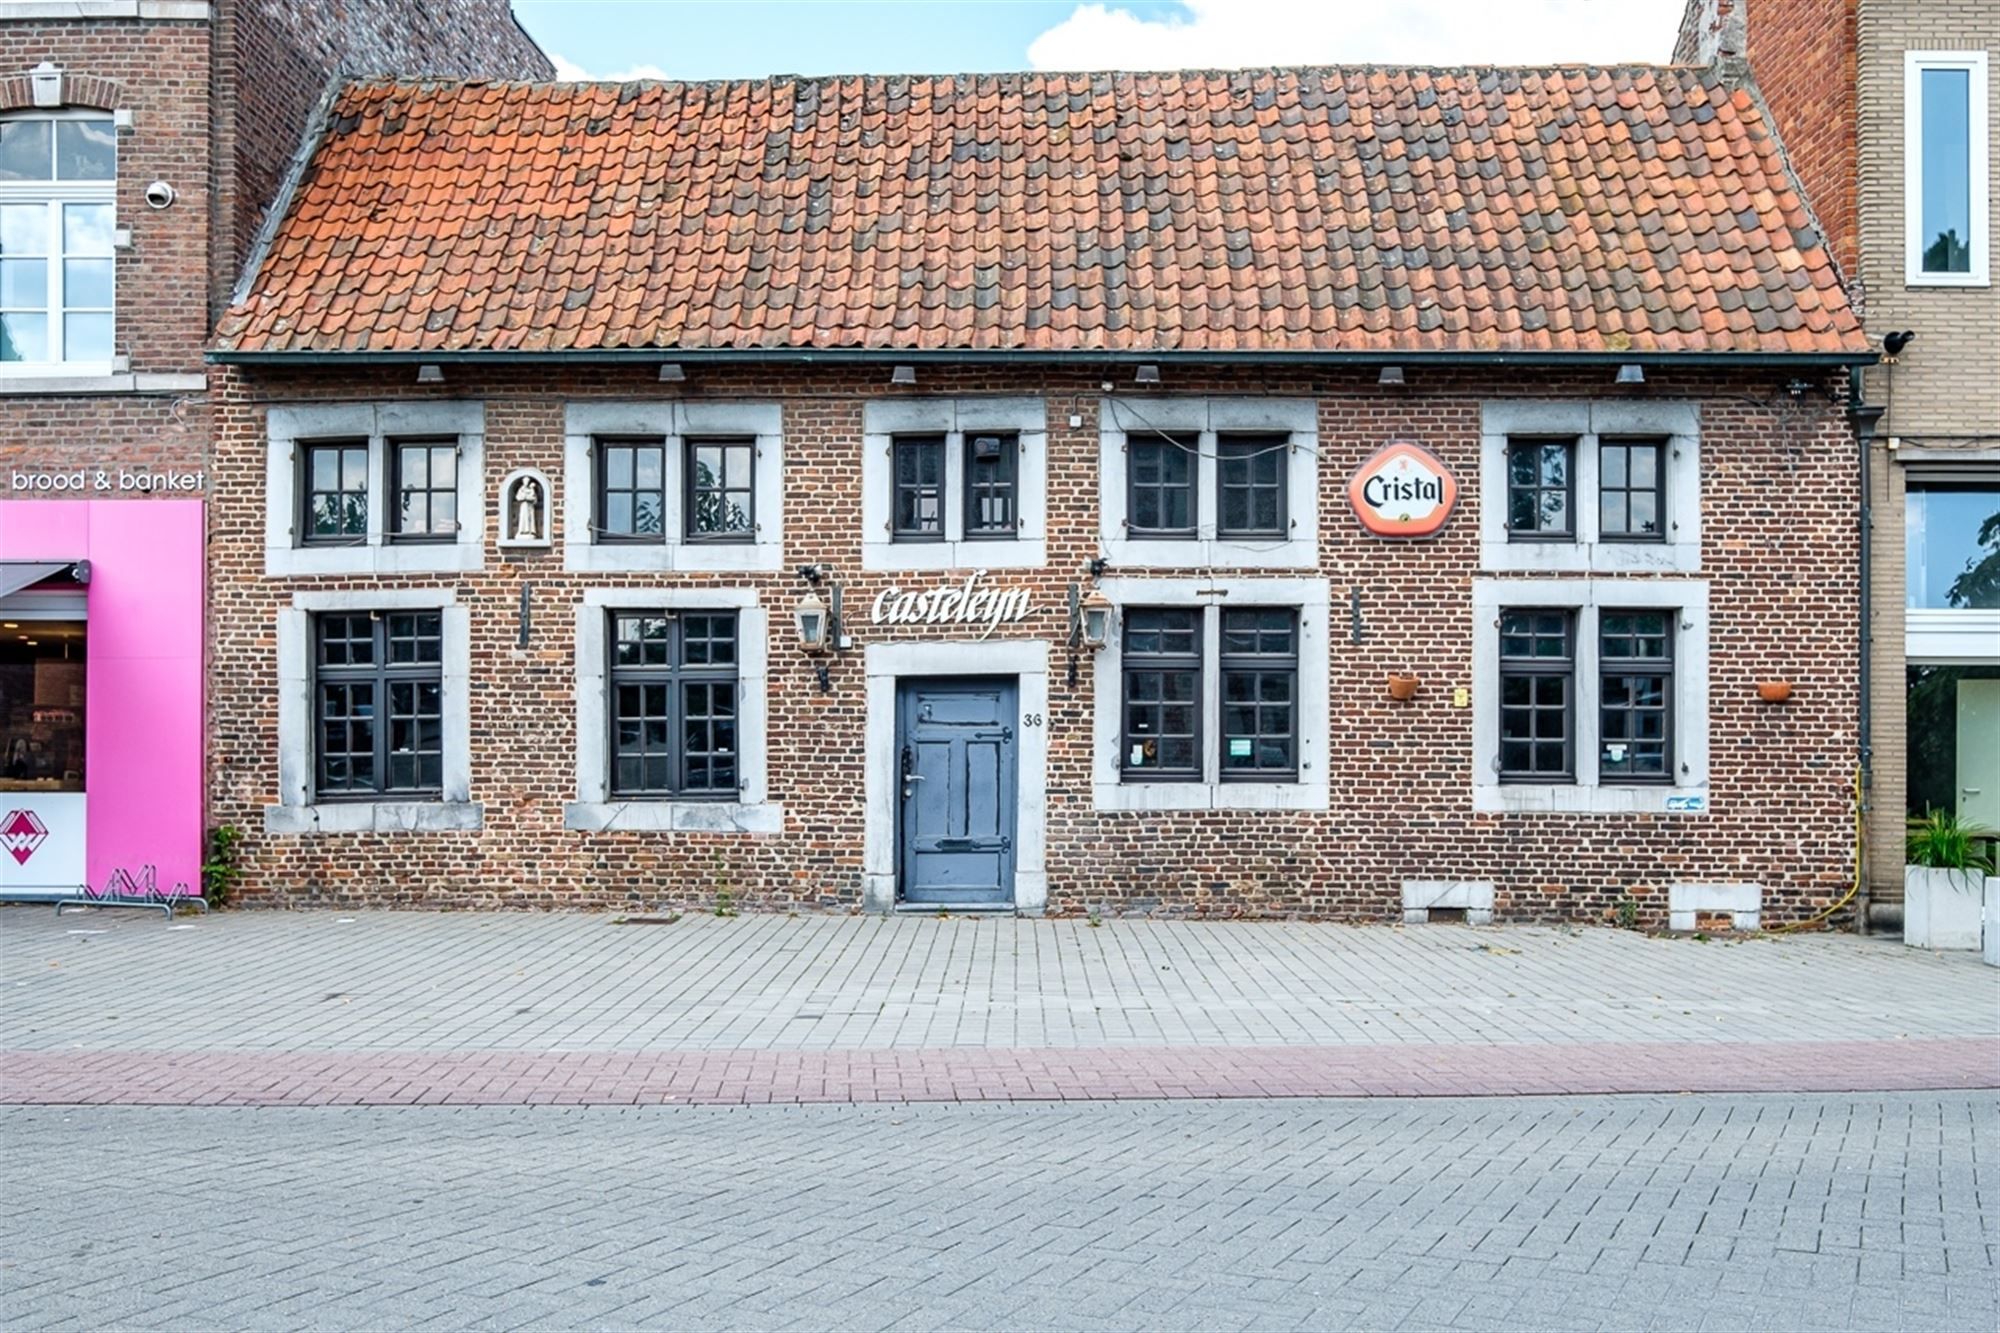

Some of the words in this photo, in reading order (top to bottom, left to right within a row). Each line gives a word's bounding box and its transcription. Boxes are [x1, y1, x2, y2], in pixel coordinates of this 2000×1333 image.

[12, 470, 85, 490] brood
[94, 470, 111, 490] &
[119, 470, 204, 490] banket
[1363, 475, 1443, 508] Cristal
[1023, 713, 1042, 727] 36
